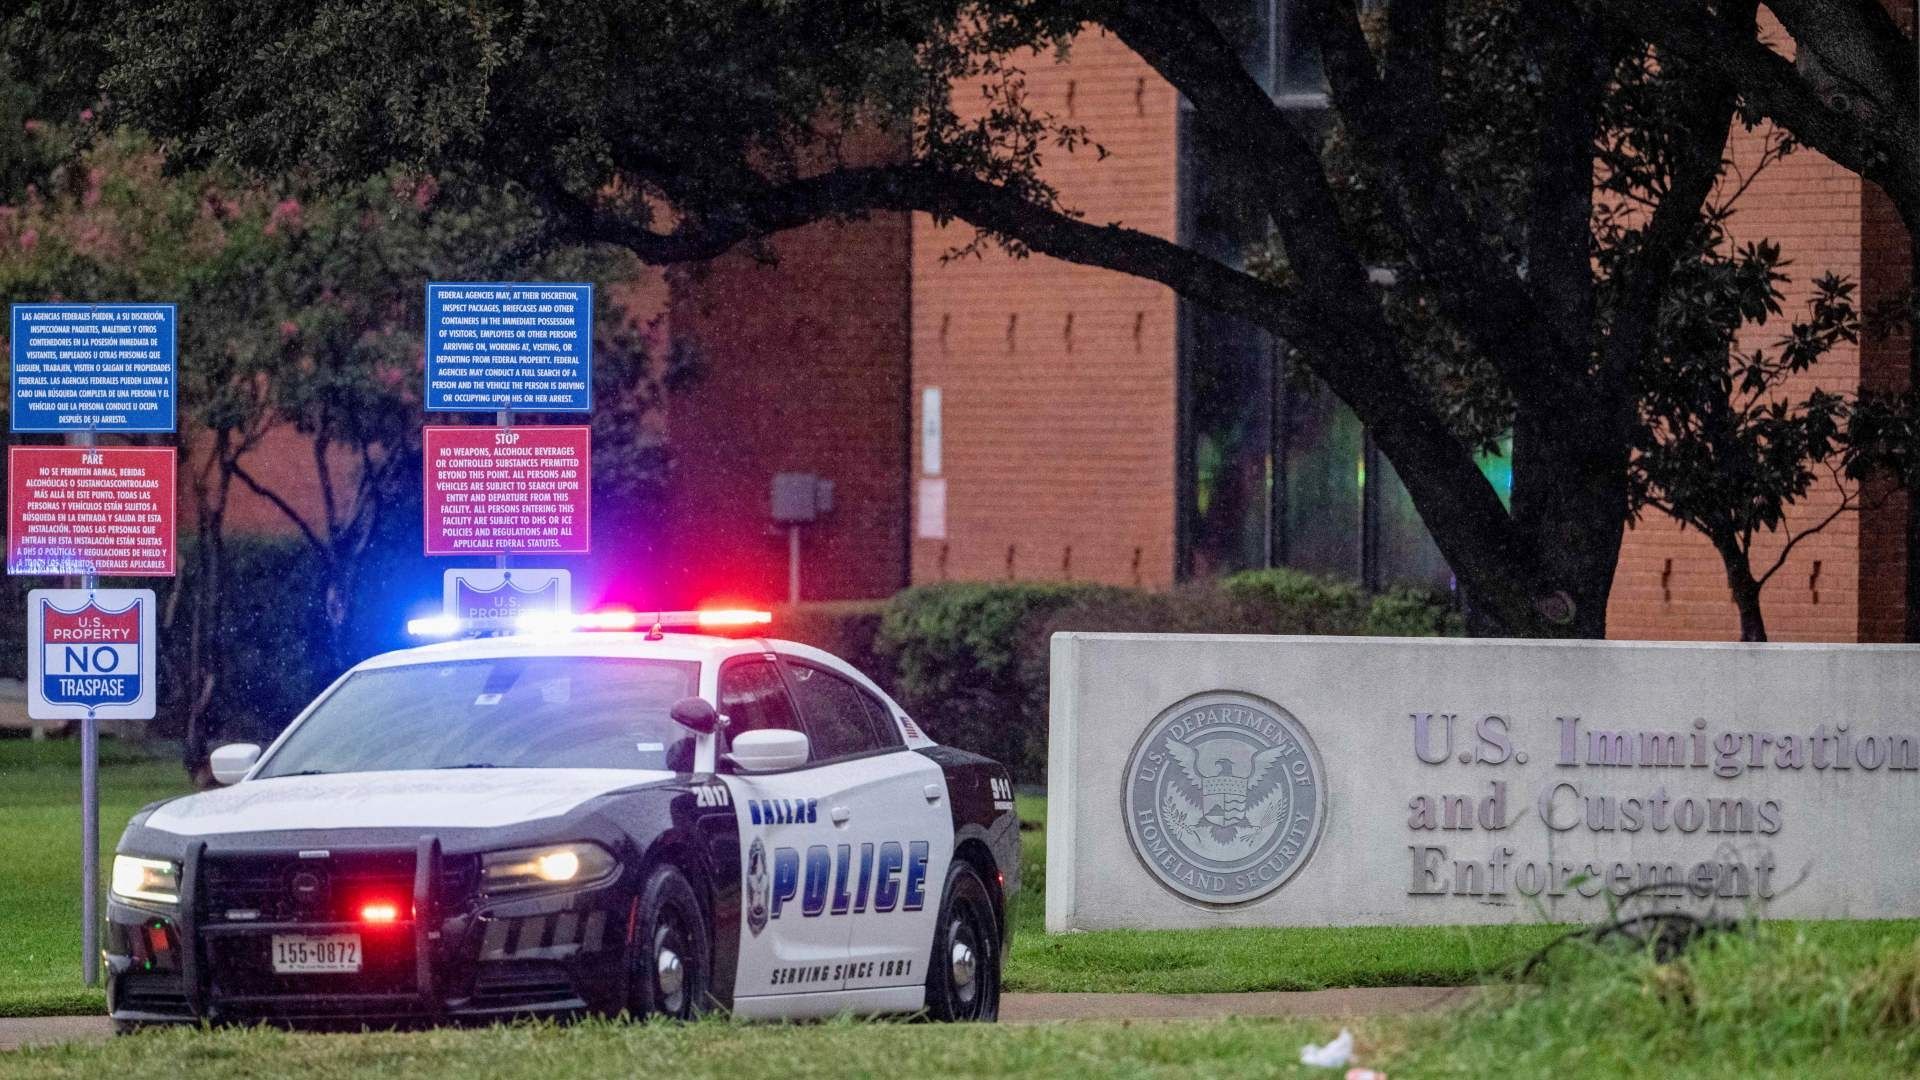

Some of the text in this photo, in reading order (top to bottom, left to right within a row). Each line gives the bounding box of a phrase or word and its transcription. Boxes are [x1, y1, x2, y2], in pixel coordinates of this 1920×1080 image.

[439, 292, 578, 300] FEDERAL AGENCIES MAY, AT THEIR DISCRETION,
[443, 304, 574, 313] INSPECT PACKAGES, BRIEFCASES AND OTHER
[442, 317, 574, 325] CONTAINERS IN THE IMMEDIATE POSSESSION
[439, 330, 577, 338] OF VISITORS, EMPLOYEES OR OTHER PERSONS
[443, 343, 572, 351] ARRIVING ON, WORKING AT, VISITING, OR
[437, 356, 579, 364] DEPARTING FROM FEDERAL PROPERTY. FEDERAL
[443, 394, 573, 402] OR OCCUPYING UPON HIS OR HER ARREST.
[496, 434, 519, 445] STOP
[440, 448, 575, 456] NO WEAPONS, ALCOHOLIC BEVERAGES
[82, 454, 103, 465] PARE
[436, 459, 579, 467] OR CONTROLLED SUBSTANCES PERMITTED
[40, 468, 145, 476] NO SE PERMITEN ARMAS, BEBIDAS
[439, 470, 576, 479] BEYOND THIS POINT. ALL PERSONS AND
[437, 482, 578, 491] VEHICLES ARE SUBJECT TO SEARCH UPON
[34, 489, 150, 499] MÁS ALLÁ DE ESTE PUNTO. TODAS LAS
[446, 493, 568, 502] ENTRY AND DEPARTURE FROM THIS
[441, 505, 574, 513] FACILITY. ALL PERSONS ENTERING THIS
[443, 516, 572, 525] FACILITY ARE SUBJECT TO DHS OR ICE
[28, 523, 155, 534] INSTALACIÓN. TODAS LAS PERSONAS QUE
[443, 528, 572, 536] POLICIES AND REGULATIONS AND ALL
[454, 539, 561, 548] APPLICABLE FEDERAL STATUTES.
[494, 597, 520, 608] U.S.
[78, 616, 105, 628] U.S.
[53, 628, 130, 639] PROPERTY
[65, 646, 119, 673] NO
[59, 678, 125, 697] TRASPASE
[1140, 708, 1311, 787] U.S. DEPARTMENT OF
[1410, 712, 1920, 778] U.S. Immigration
[990, 778, 1012, 800] 911
[692, 785, 728, 807] 2017
[749, 799, 817, 825] DALLAS
[1408, 781, 1783, 835] and Customs
[1139, 809, 1309, 890] HOMELAND SECURITY
[1408, 846, 1775, 899] Enforcement
[771, 841, 930, 919] POLICE
[771, 960, 913, 984] SERVING SINCE 1881
